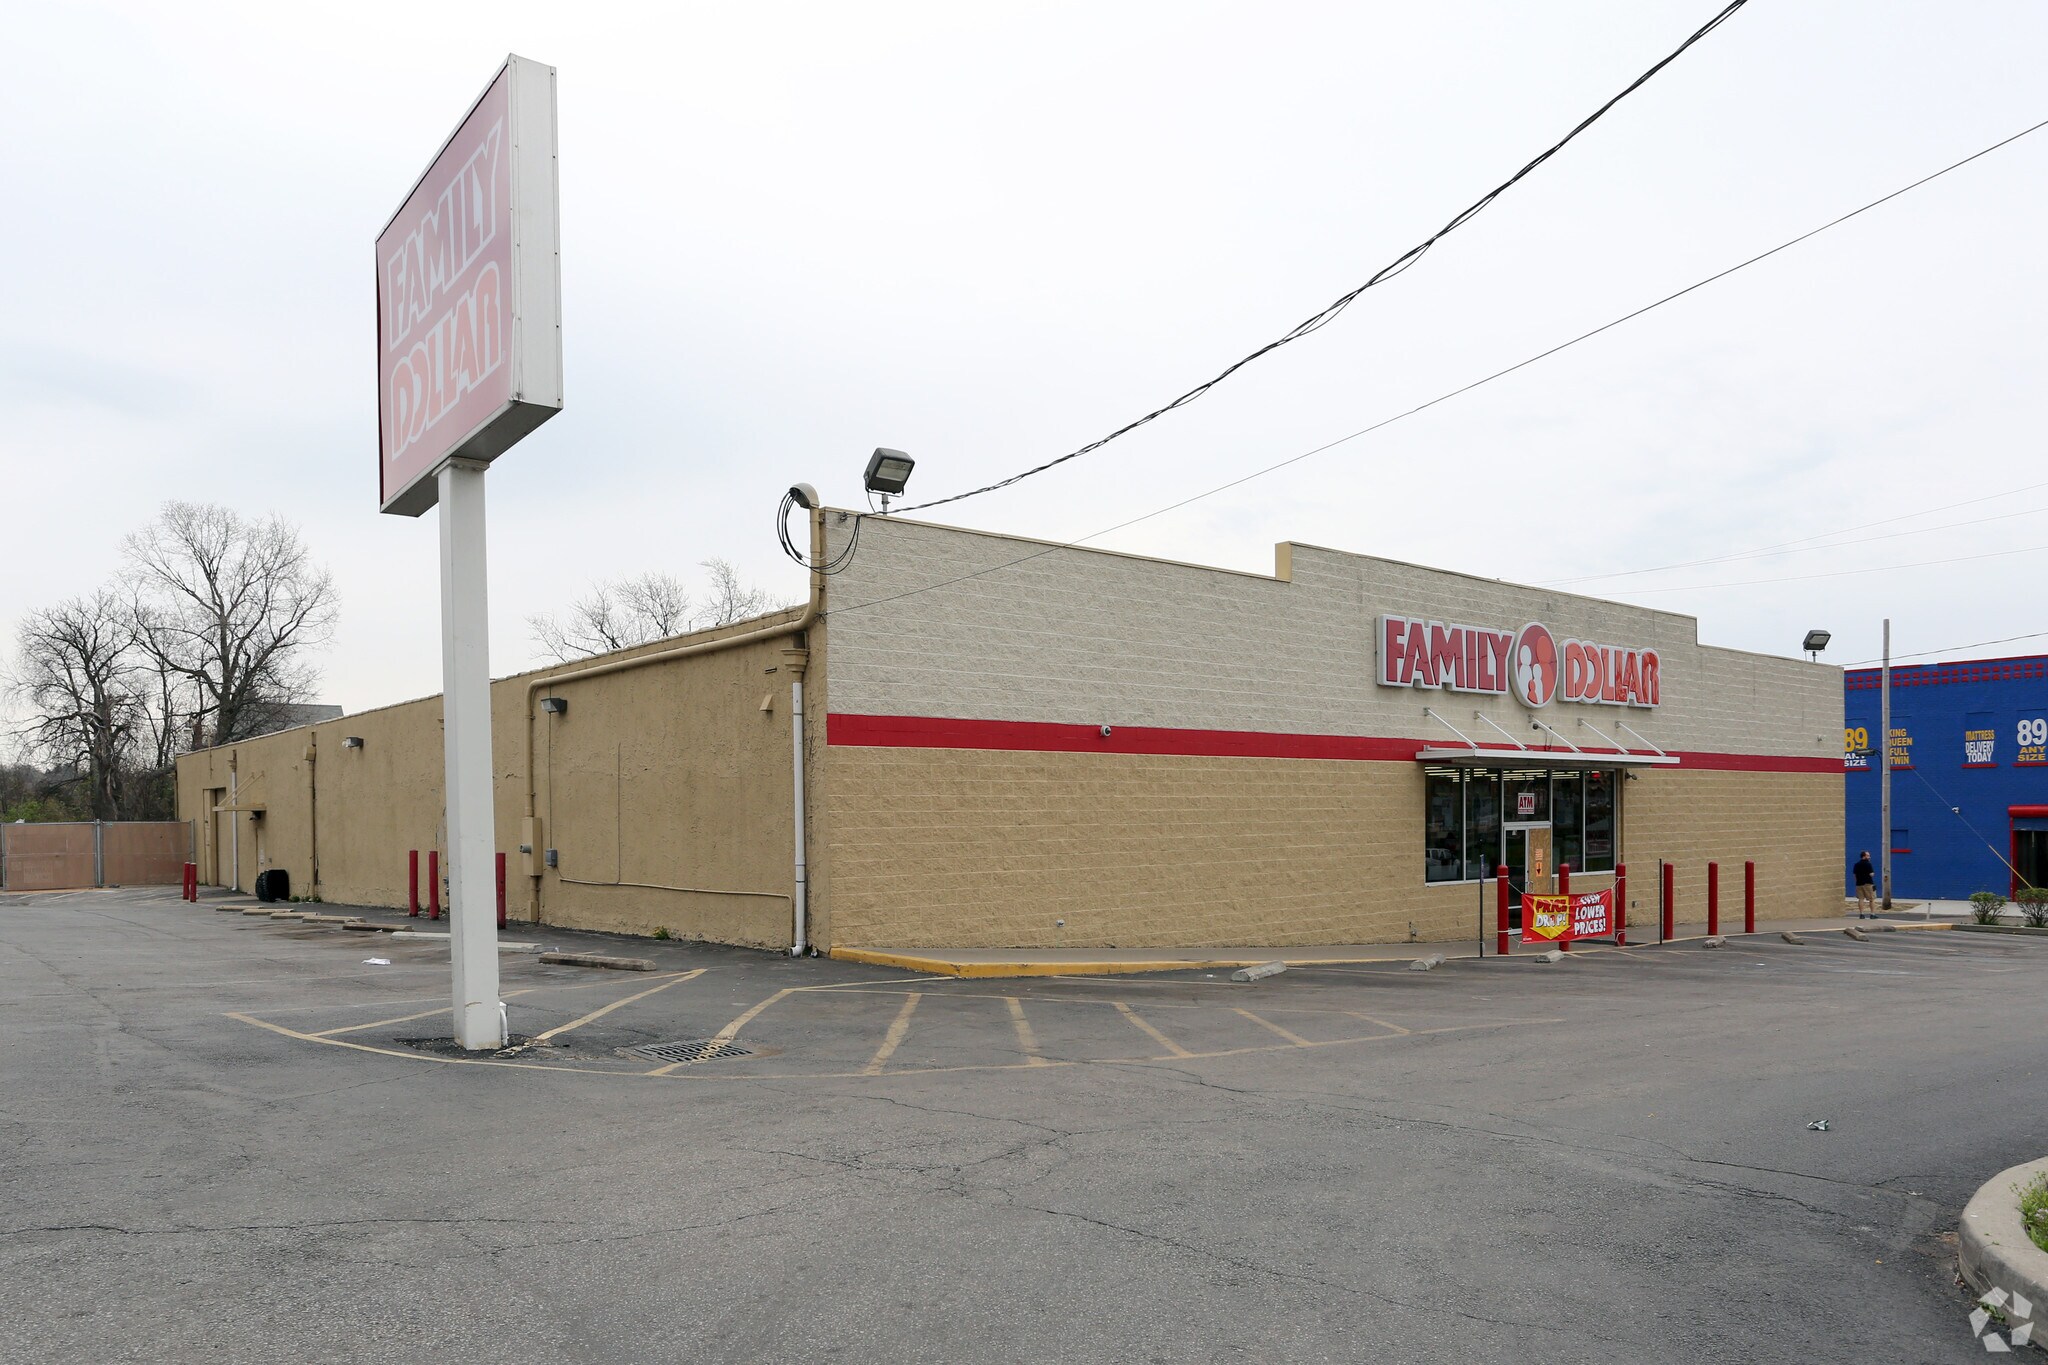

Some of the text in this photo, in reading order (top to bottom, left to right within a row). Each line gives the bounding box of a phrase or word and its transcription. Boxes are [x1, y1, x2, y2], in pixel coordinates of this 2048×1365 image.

[389, 116, 502, 352] FAMILY
[391, 261, 501, 460] DOLLAR
[1382, 617, 1660, 706] FAMILY DOLLAR
[1965, 730, 1995, 741] MATTRESS
[2017, 719, 2047, 746] 89
[1844, 727, 1869, 752] 89
[1889, 737, 1913, 746] UEEN
[1889, 747, 1909, 756] FULL
[1965, 741, 1995, 753] DELIVERY
[1844, 759, 1867, 767] SIZE
[1889, 756, 1910, 765] TWIN
[1967, 752, 1992, 763] TODAY
[2017, 753, 2046, 761] SIZE
[1519, 796, 1533, 808] ATM
[1535, 899, 1567, 913] PRICE
[1575, 905, 1606, 920] LOWER
[1535, 912, 1567, 927] DROP!
[1574, 918, 1606, 936] PRICES!
